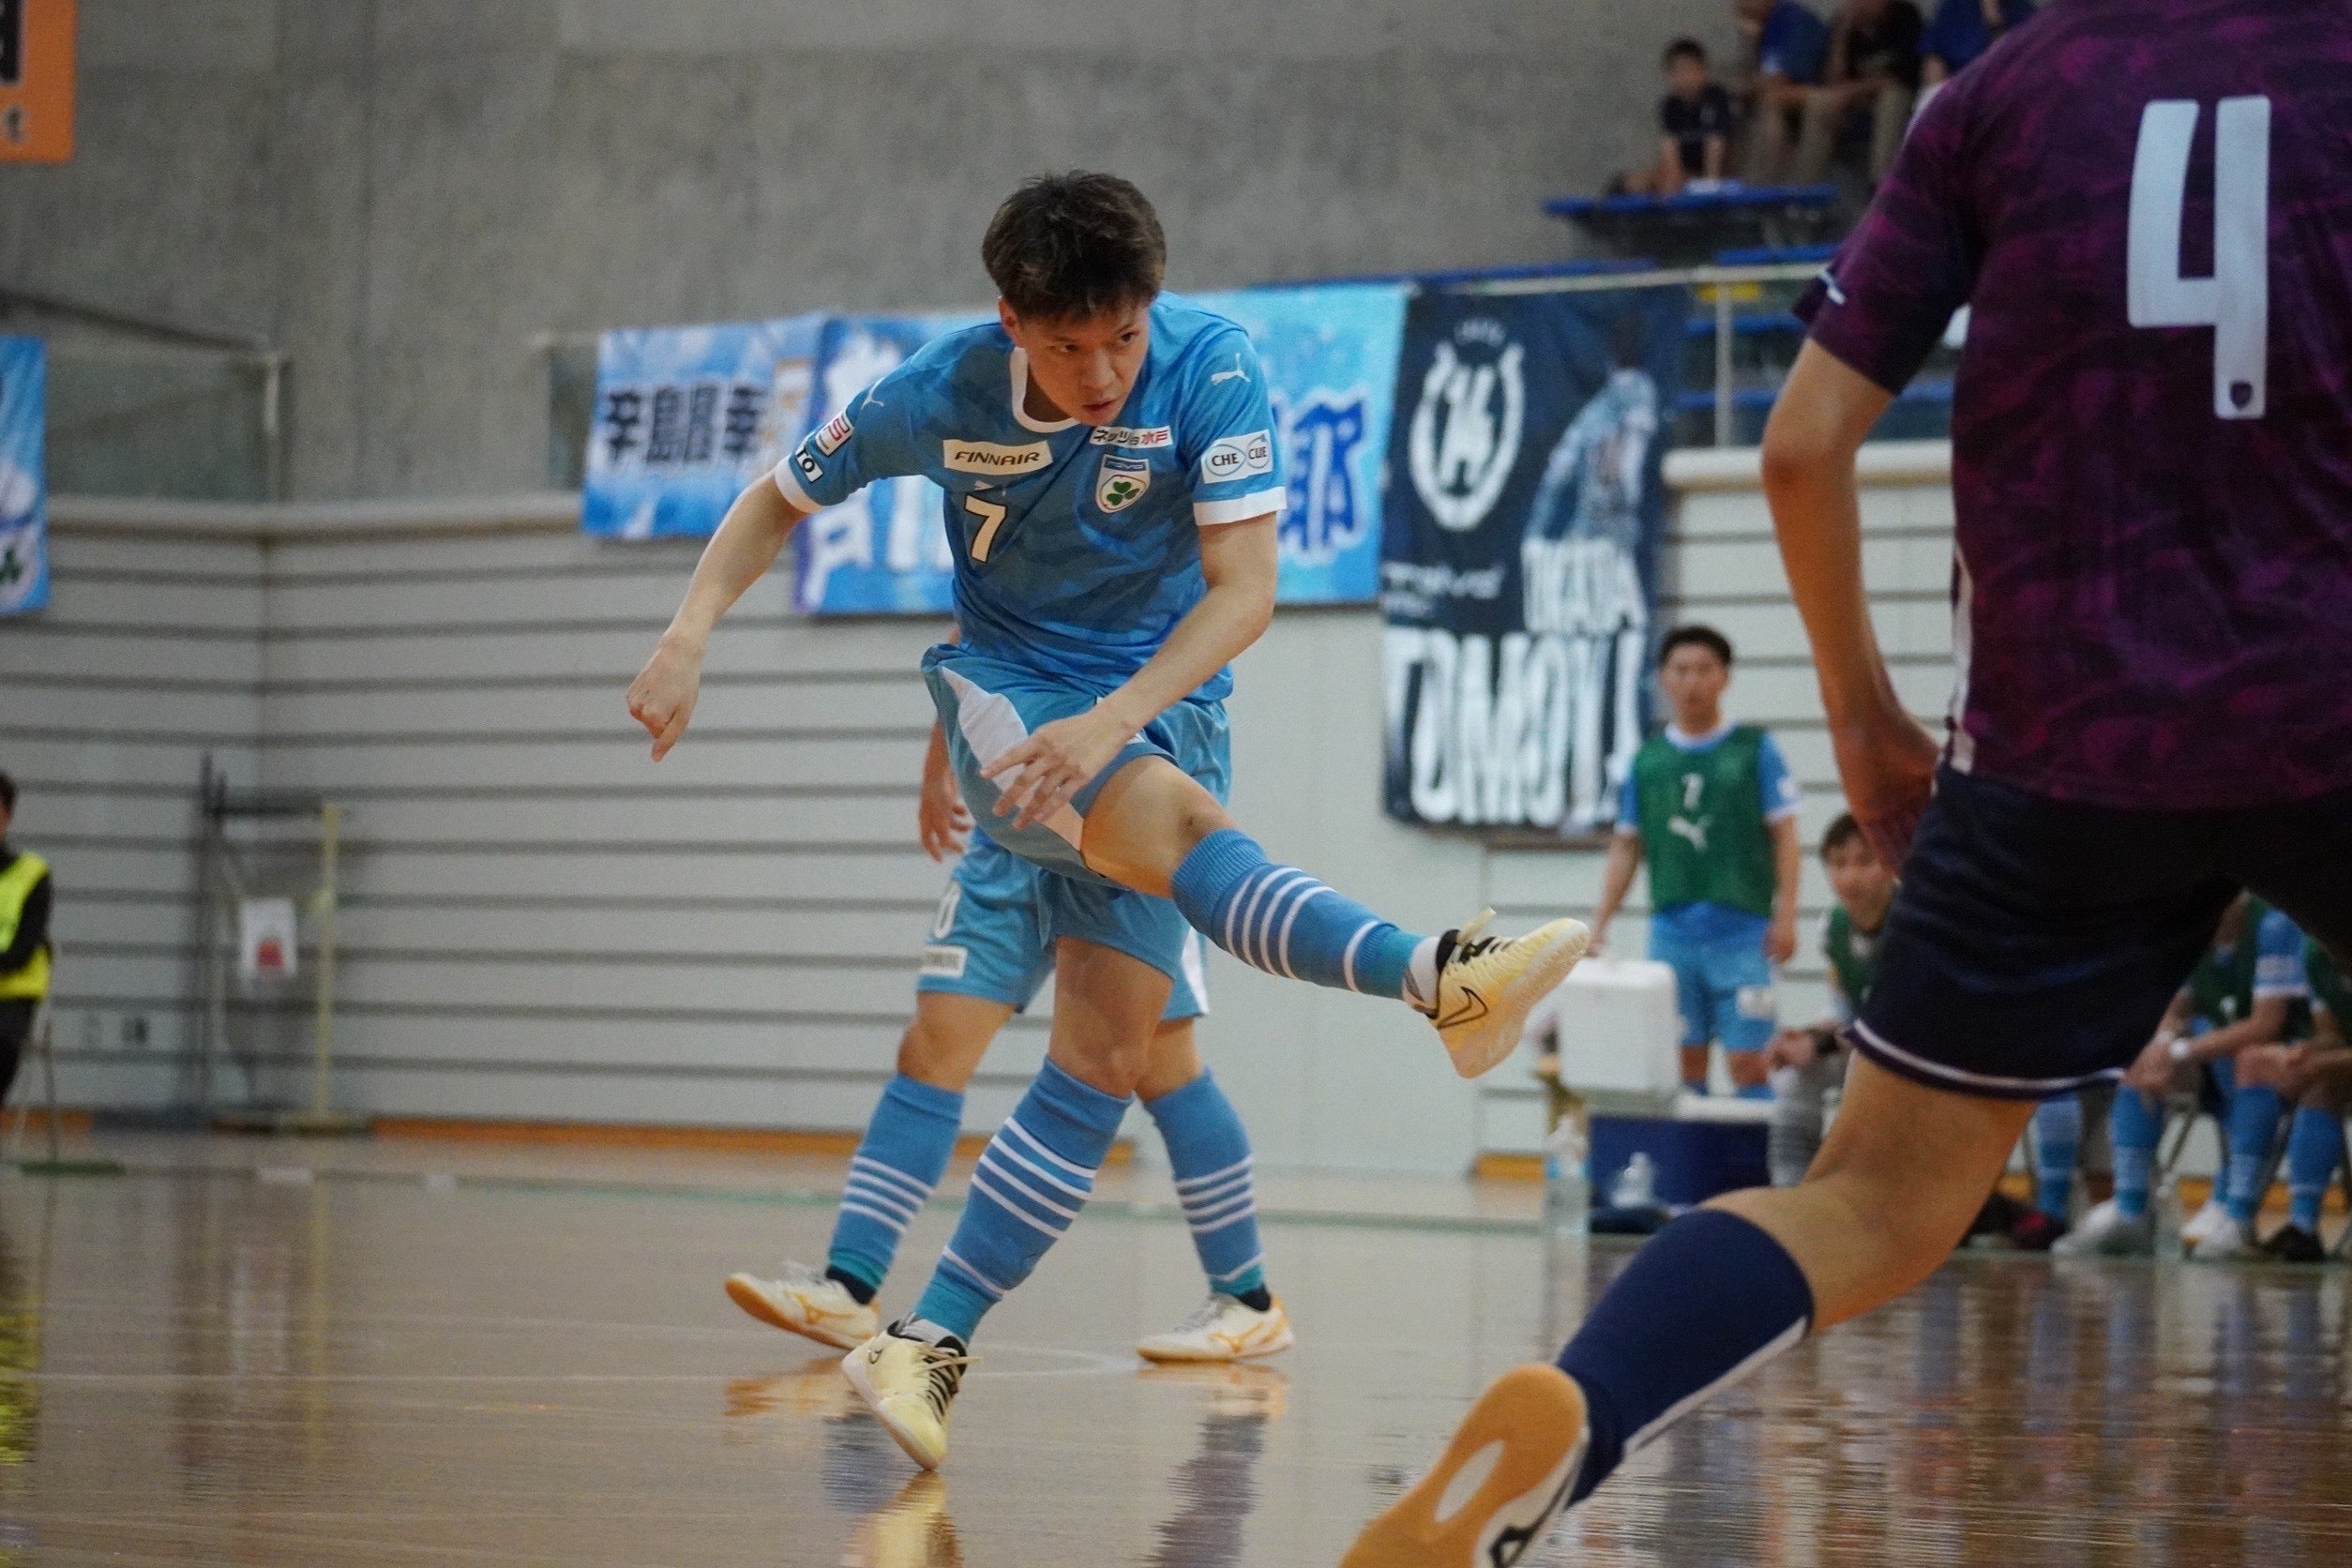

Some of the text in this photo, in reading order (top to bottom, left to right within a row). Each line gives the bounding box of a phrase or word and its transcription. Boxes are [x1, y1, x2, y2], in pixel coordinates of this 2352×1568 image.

[2127, 96, 2270, 419] 4
[954, 450, 1041, 466] FINNAIR
[1212, 446, 1267, 467] CHE CUE
[964, 496, 1006, 563] 7
